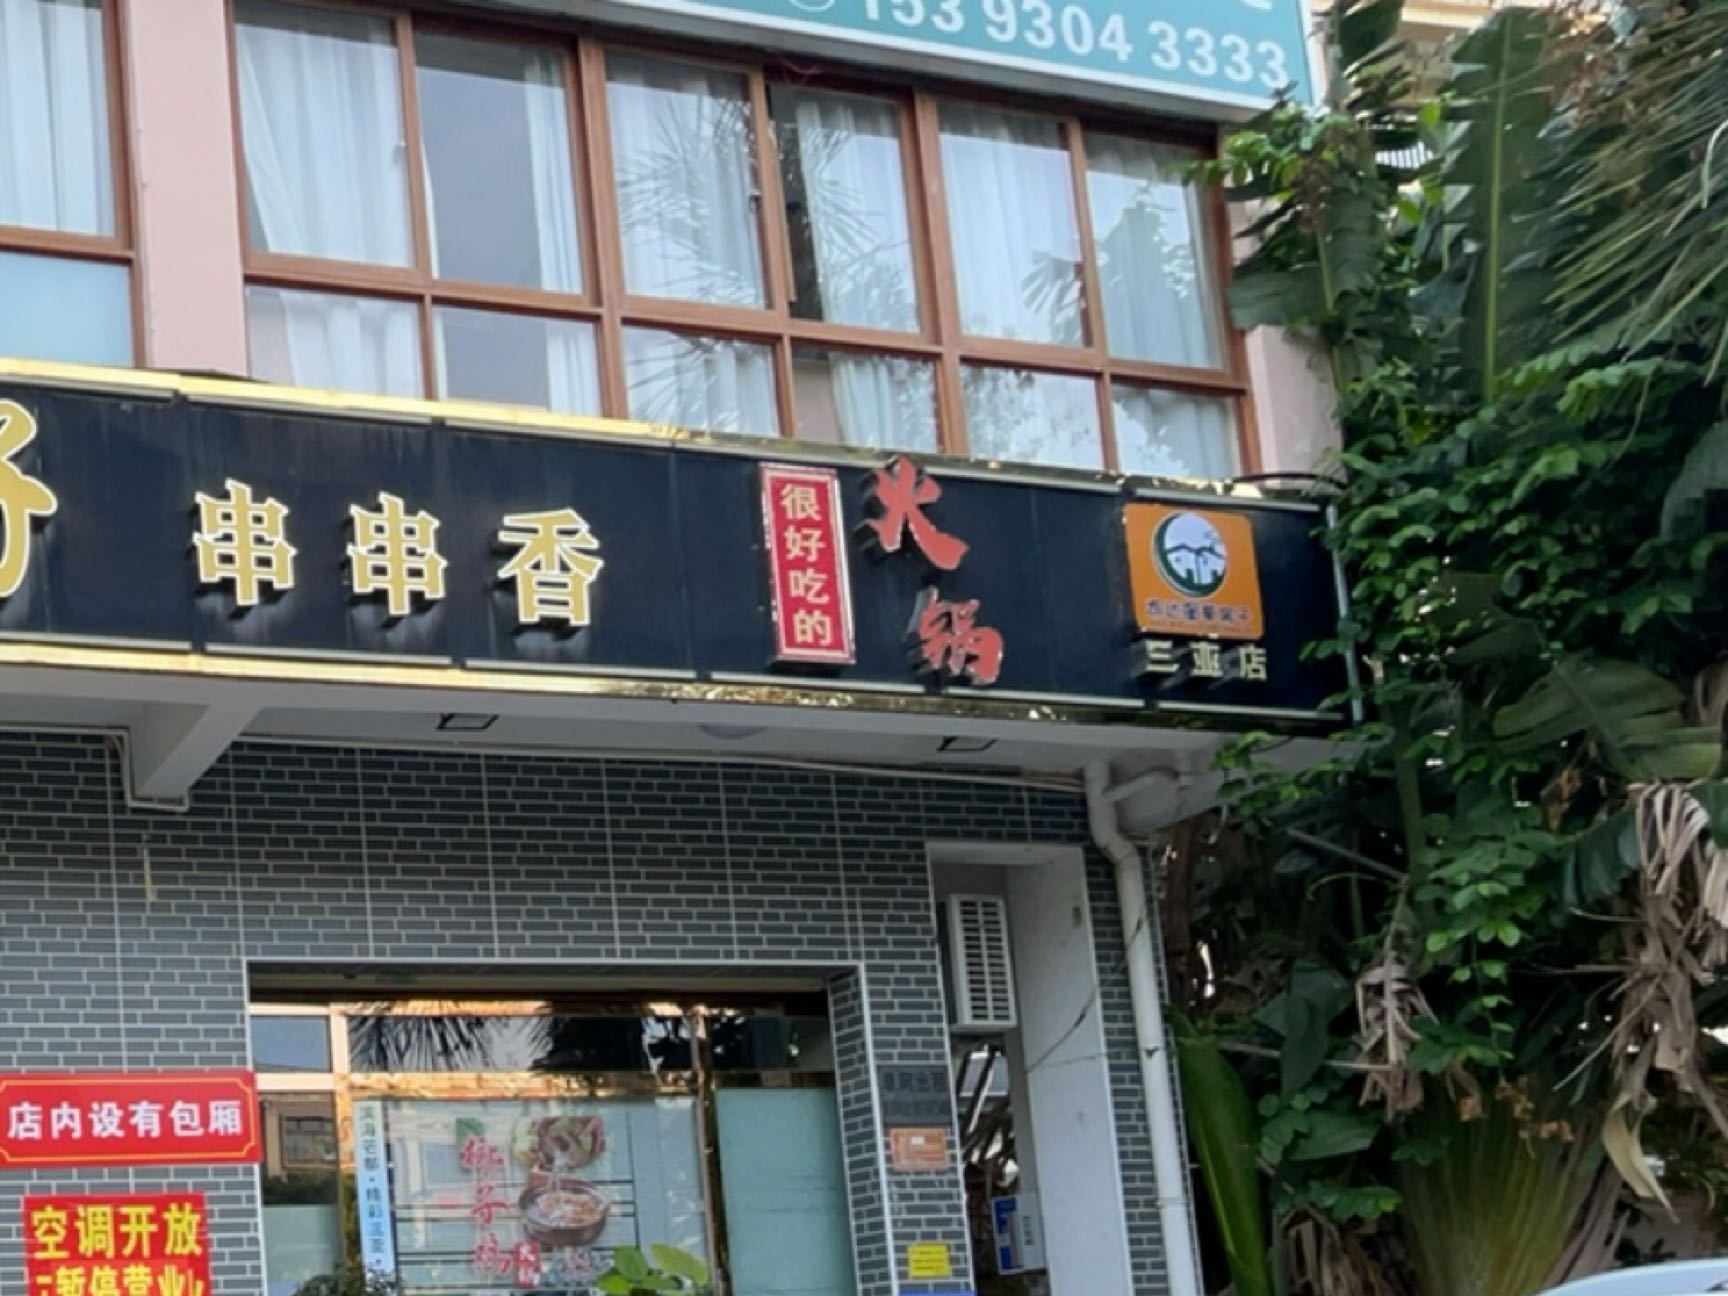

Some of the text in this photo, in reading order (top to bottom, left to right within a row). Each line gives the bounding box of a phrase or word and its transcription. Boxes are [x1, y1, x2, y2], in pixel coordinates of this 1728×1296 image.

[983, 0, 1134, 61] 9304
[1147, 21, 1289, 89] 3333
[193, 477, 604, 628] 串串香
[779, 483, 834, 647] 很好吃的
[860, 455, 1004, 684] 火锅
[1144, 639, 1268, 681] 三亚店
[7, 1100, 242, 1140] 店内设有包厢
[30, 1202, 203, 1260] 空调开放
